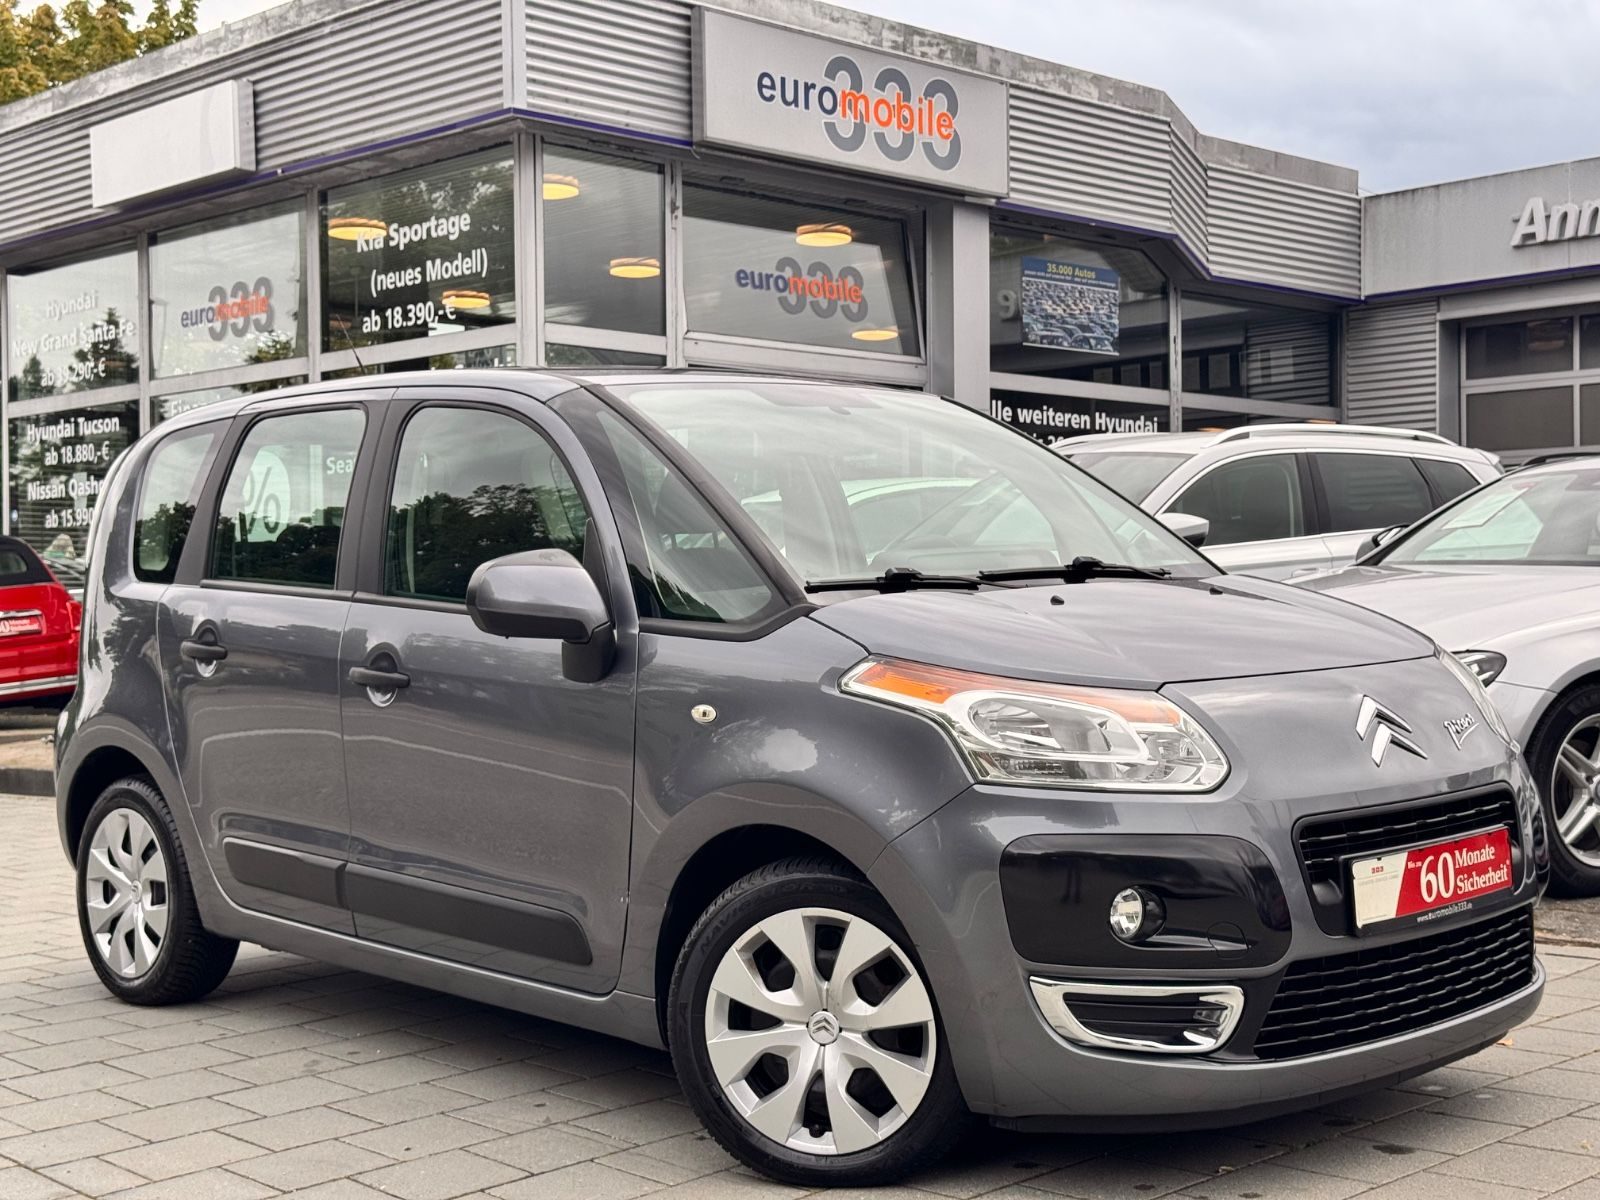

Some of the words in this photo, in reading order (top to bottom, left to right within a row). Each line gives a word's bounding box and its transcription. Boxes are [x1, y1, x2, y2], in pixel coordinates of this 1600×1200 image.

[756, 71, 955, 141] euromobile
[823, 55, 963, 172] 333
[388, 212, 471, 250] Sportage
[370, 268, 422, 297] (neues
[426, 248, 488, 283] Modell)
[735, 268, 863, 304] euromobile
[1046, 263, 1073, 276] 35.000
[1074, 267, 1097, 279] Autos
[775, 256, 869, 323] 333
[46, 290, 98, 321] Hyundai
[181, 294, 270, 328] euromobile
[207, 276, 275, 342] 333
[362, 309, 381, 333] ab
[12, 338, 38, 358] New
[40, 328, 77, 352] Grand
[79, 324, 116, 347] Santa
[118, 319, 134, 337] Fe
[40, 368, 55, 387] ab
[27, 417, 75, 443] Hyundai
[79, 416, 120, 436] Tucson
[1017, 405, 1091, 430] weiteren
[1095, 412, 1158, 433] Hyundai
[45, 447, 59, 466] ab
[326, 456, 355, 475] Sea
[27, 481, 66, 501] Nissan
[45, 509, 59, 528] ab
[1454, 842, 1496, 870] Monate
[1420, 852, 1456, 903] 60
